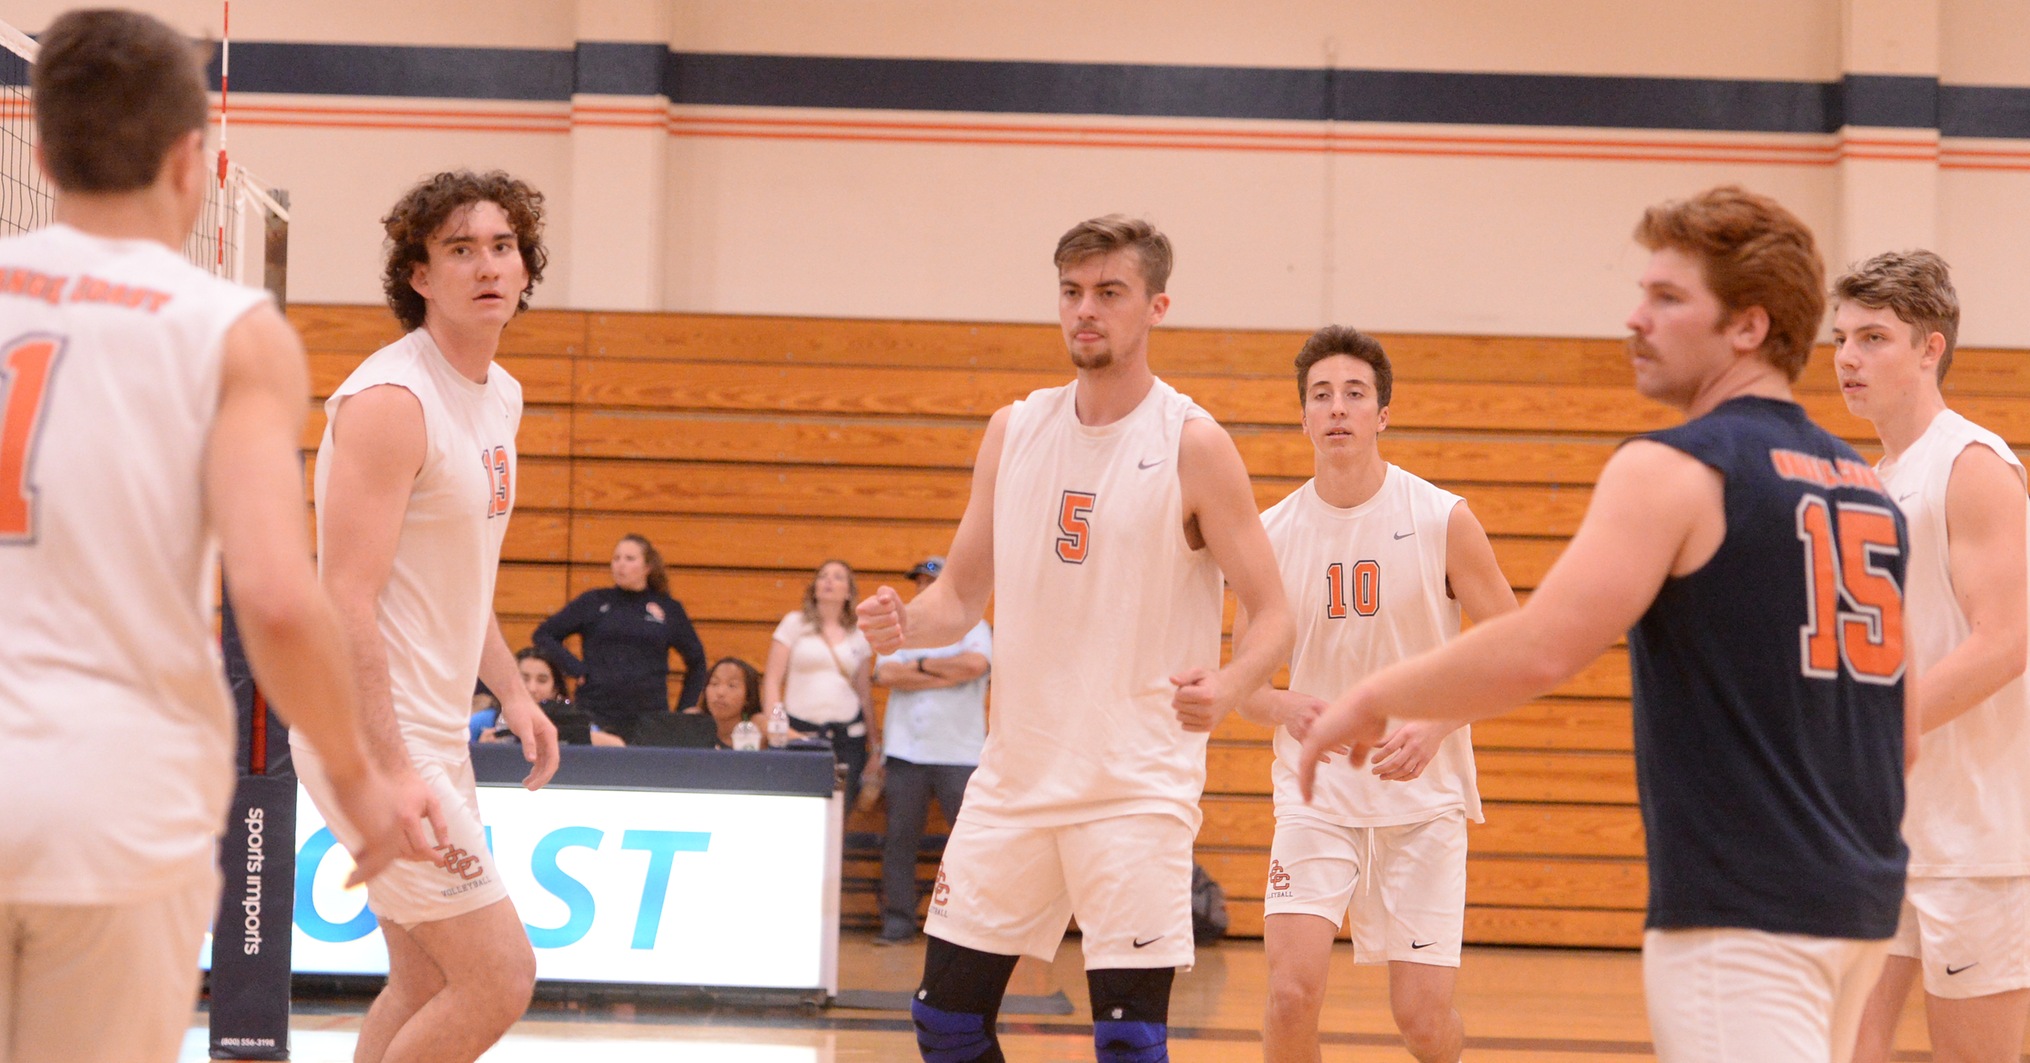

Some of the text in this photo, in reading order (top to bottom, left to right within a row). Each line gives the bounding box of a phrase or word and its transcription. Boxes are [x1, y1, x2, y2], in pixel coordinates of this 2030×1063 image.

[481, 445, 511, 519] 13
[1055, 489, 1097, 565] 5
[1326, 559, 1381, 619] 10
[1795, 493, 1908, 687] 15
[241, 806, 265, 956] sports imports
[440, 876, 492, 897] VOLLEYBALL
[220, 1037, 240, 1047] (800)
